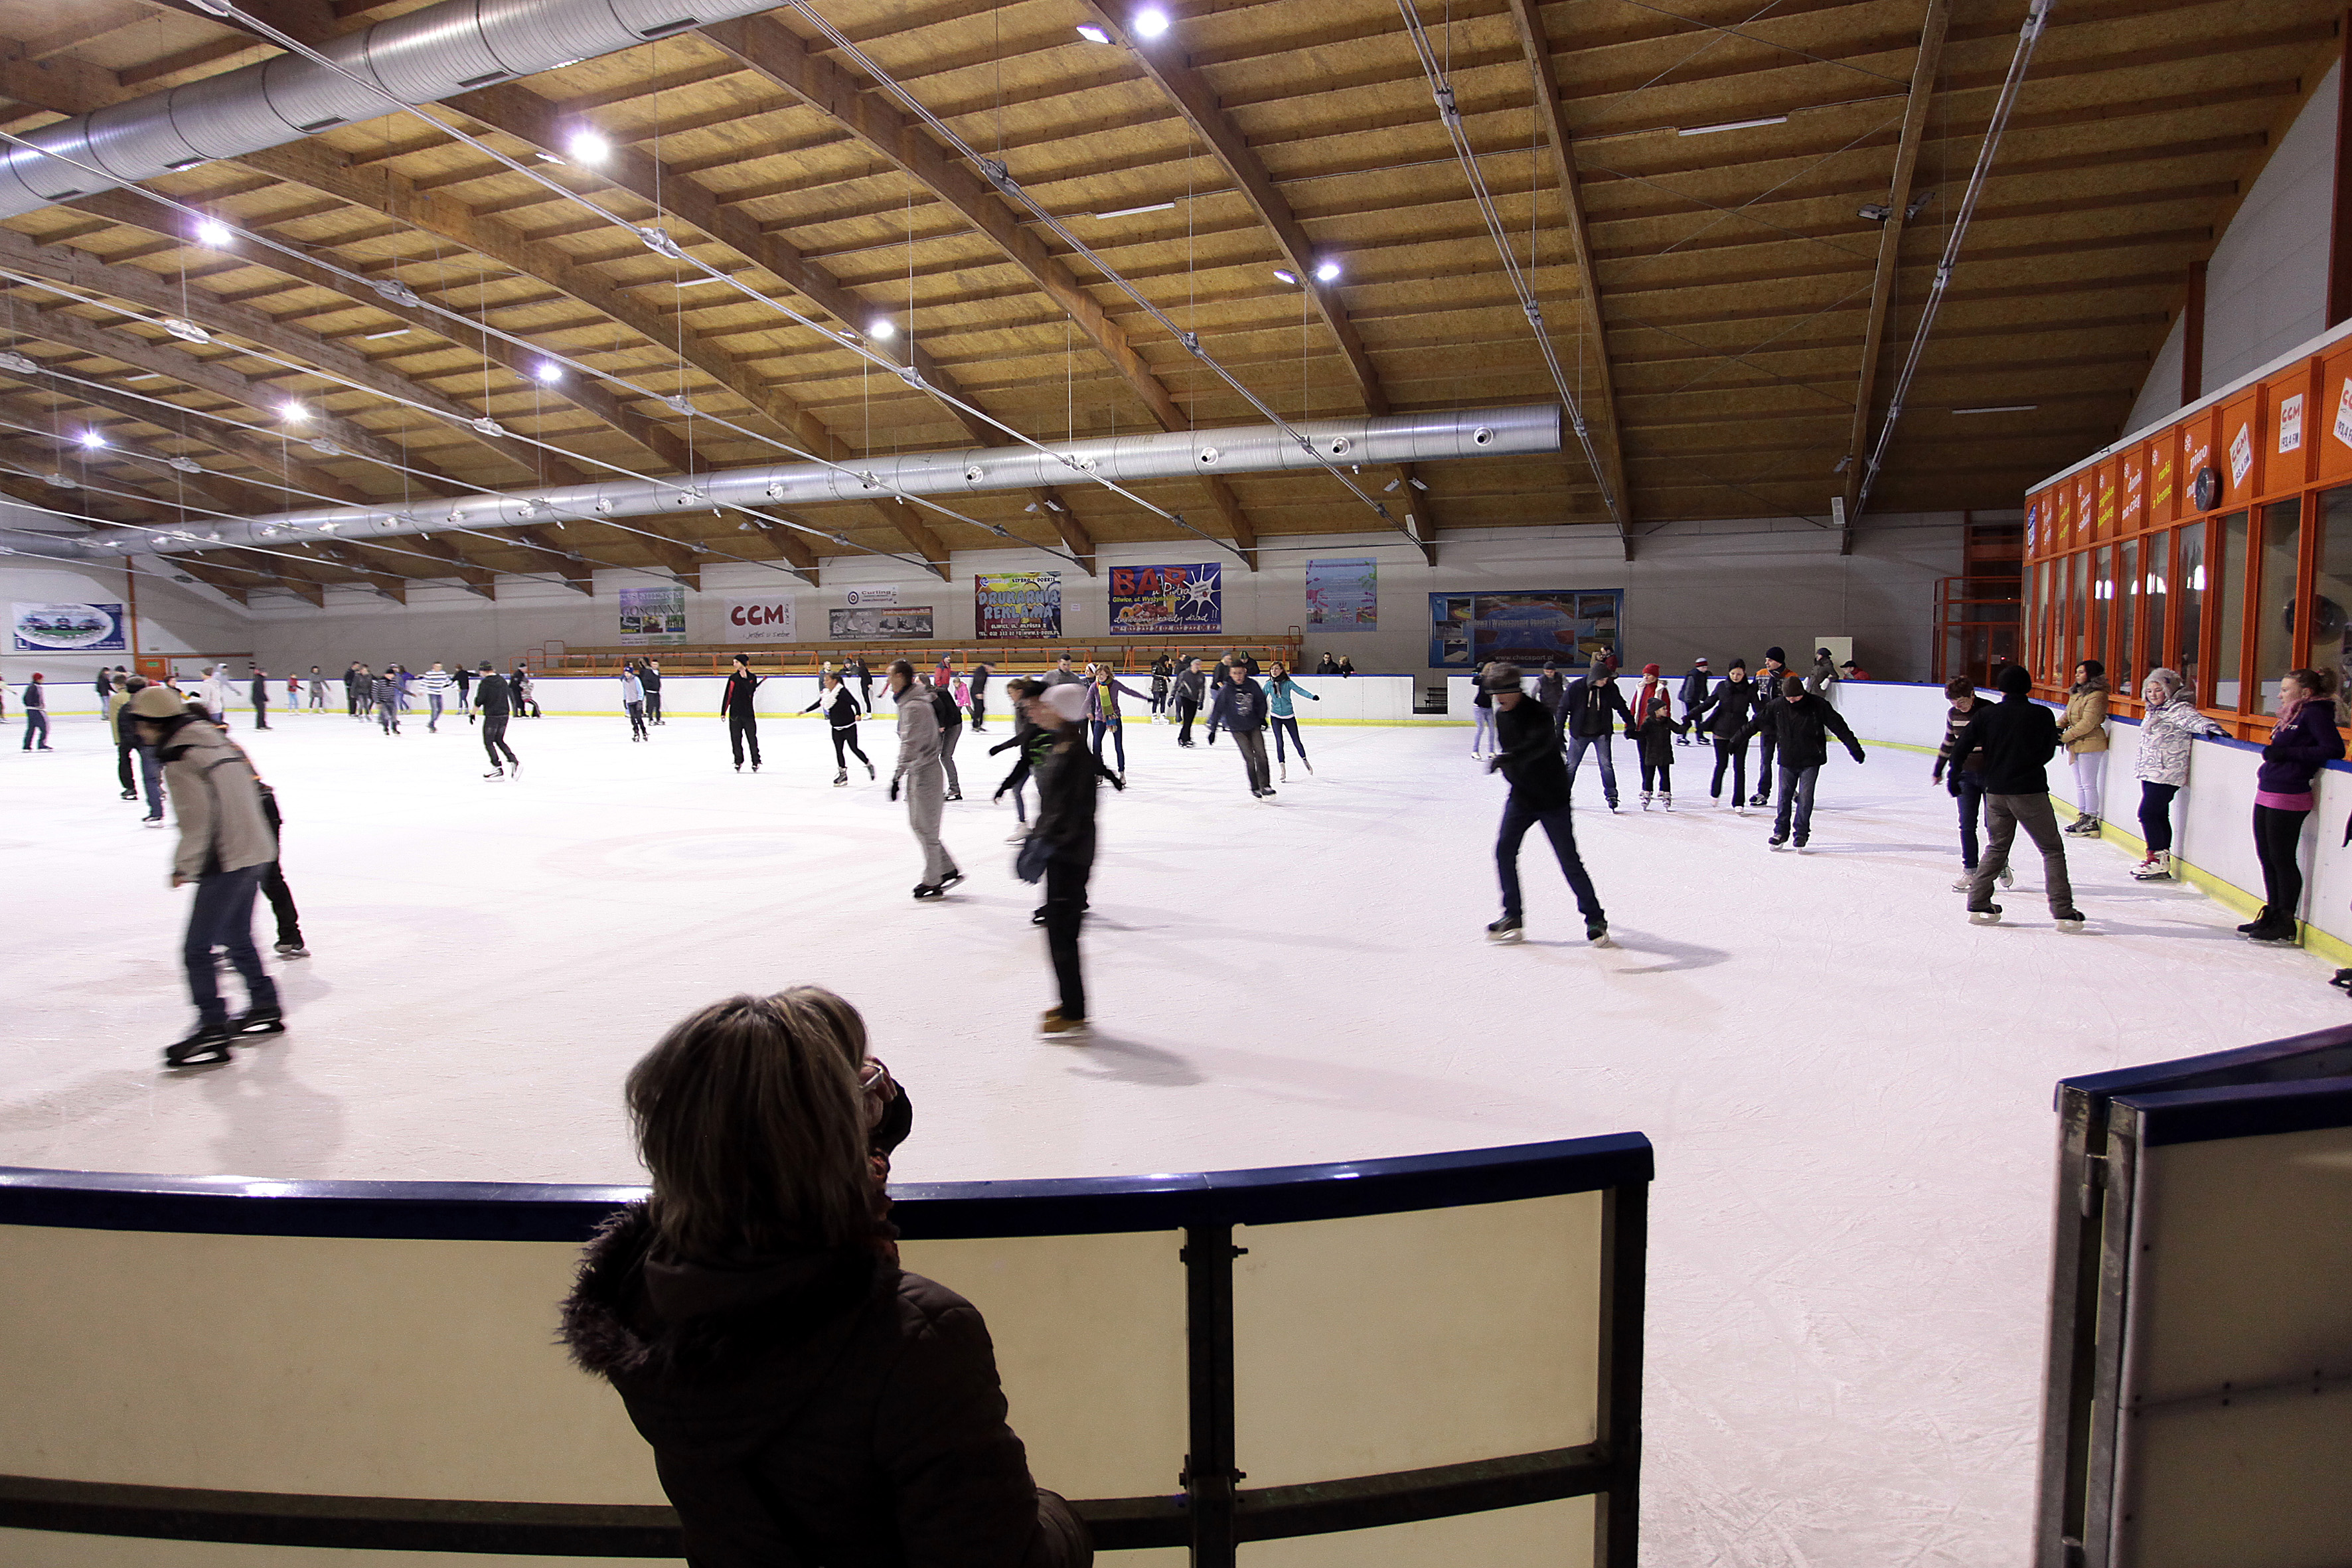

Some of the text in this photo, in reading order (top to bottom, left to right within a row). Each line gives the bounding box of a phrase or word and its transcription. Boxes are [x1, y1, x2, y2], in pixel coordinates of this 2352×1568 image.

[2282, 403, 2300, 423] CCM
[2232, 431, 2246, 463] CCM
[2189, 445, 2207, 474] piwo
[1113, 568, 1188, 595] BAR
[978, 590, 1059, 605] DRUKARNIA
[731, 604, 784, 626] CCM
[984, 605, 1053, 619] REKLAMA
